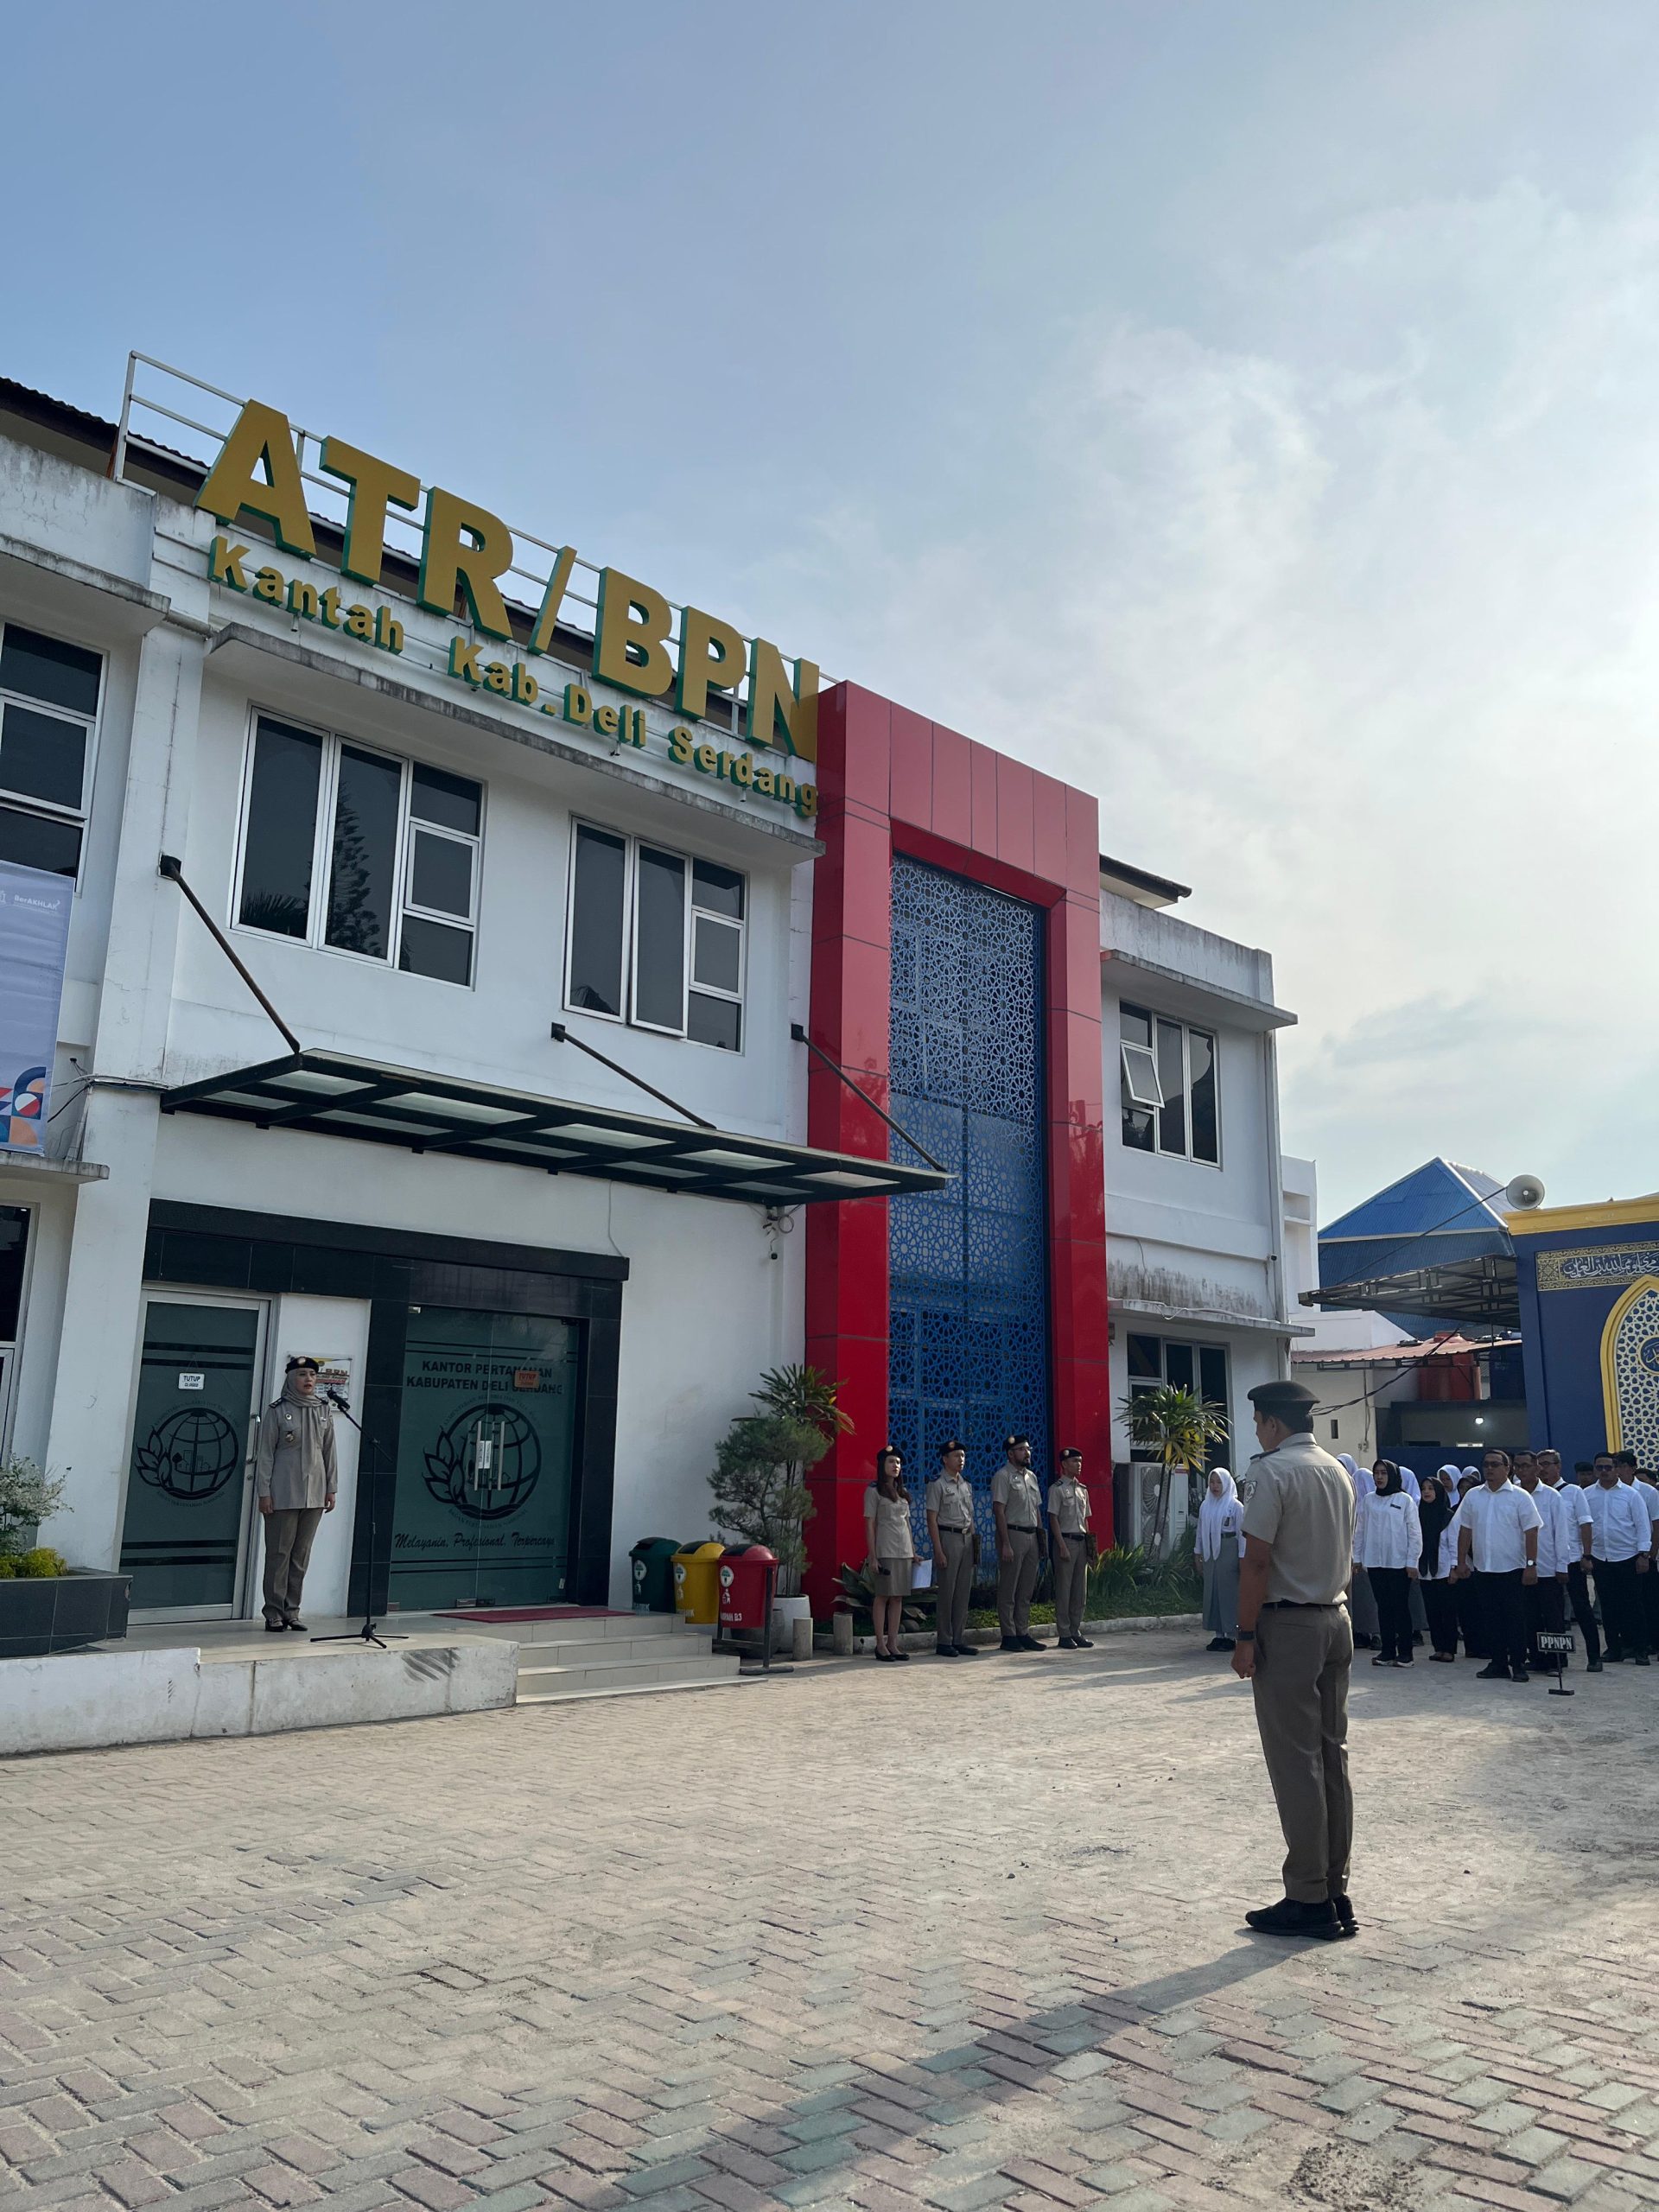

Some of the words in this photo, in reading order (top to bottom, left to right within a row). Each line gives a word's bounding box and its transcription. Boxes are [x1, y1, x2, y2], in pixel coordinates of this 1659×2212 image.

[207, 535, 404, 656] Kantah
[448, 635, 556, 716] Kab.
[563, 683, 647, 749] Deli
[668, 725, 818, 819] Serdang
[423, 1360, 472, 1373] KANTOR
[406, 1376, 479, 1389] KABUPATEN
[481, 1380, 508, 1392] DELI
[1541, 1636, 1573, 1649] PPNPN
